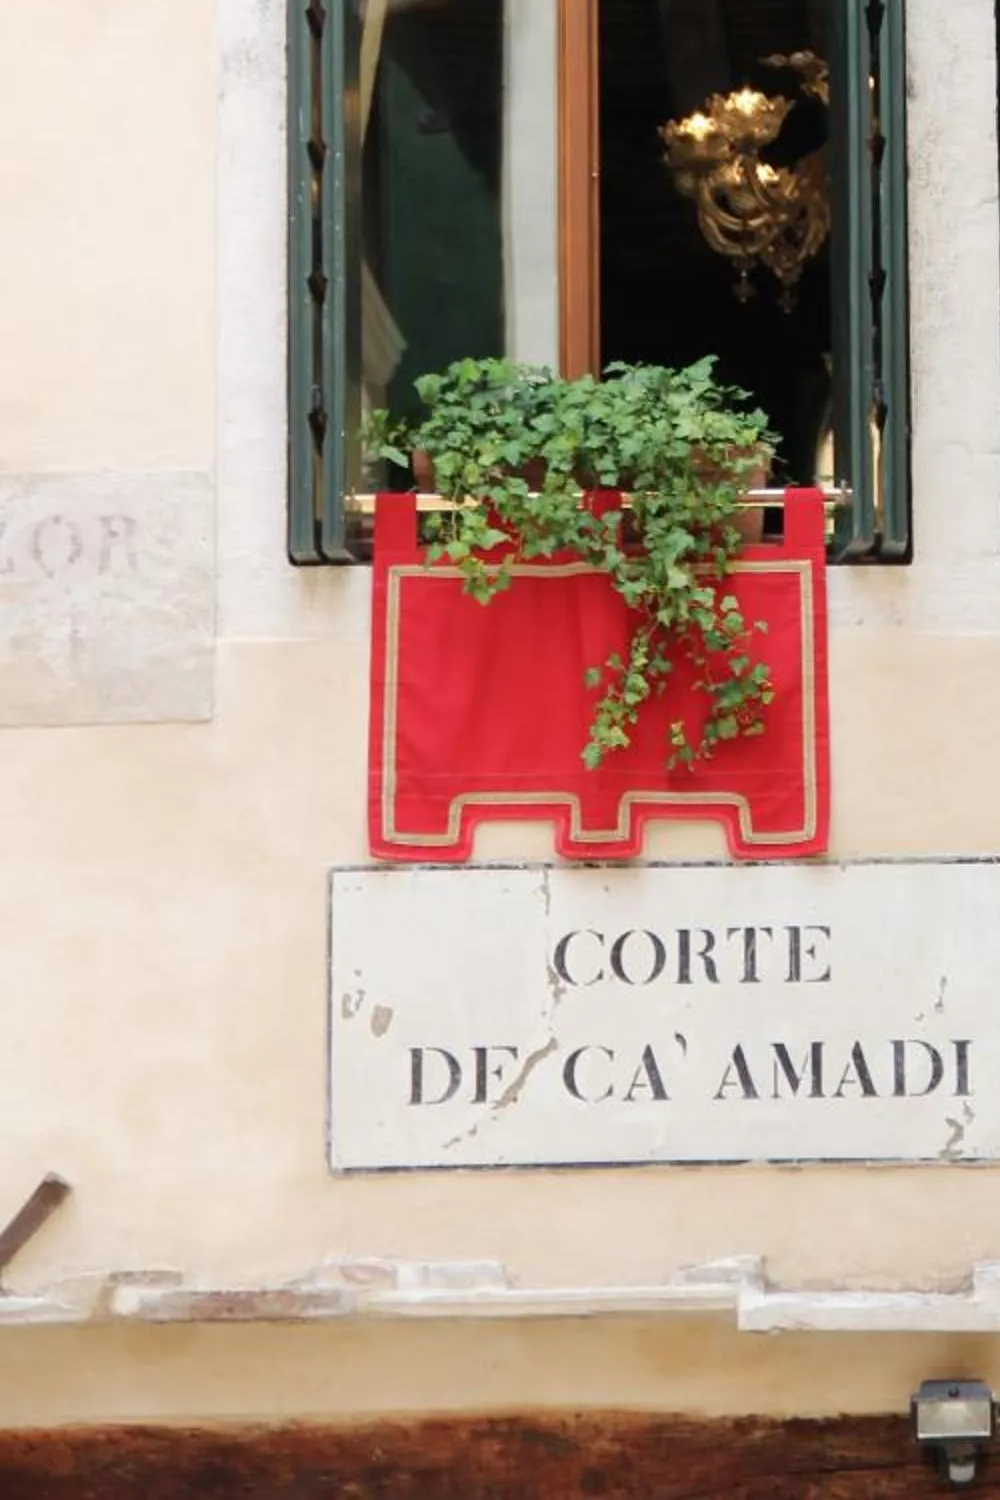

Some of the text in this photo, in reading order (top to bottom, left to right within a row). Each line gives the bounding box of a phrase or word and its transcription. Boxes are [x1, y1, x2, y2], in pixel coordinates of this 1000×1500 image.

[553, 926, 832, 987] CORTE
[562, 1031, 687, 1103] CA'
[712, 1039, 975, 1099] AMADI
